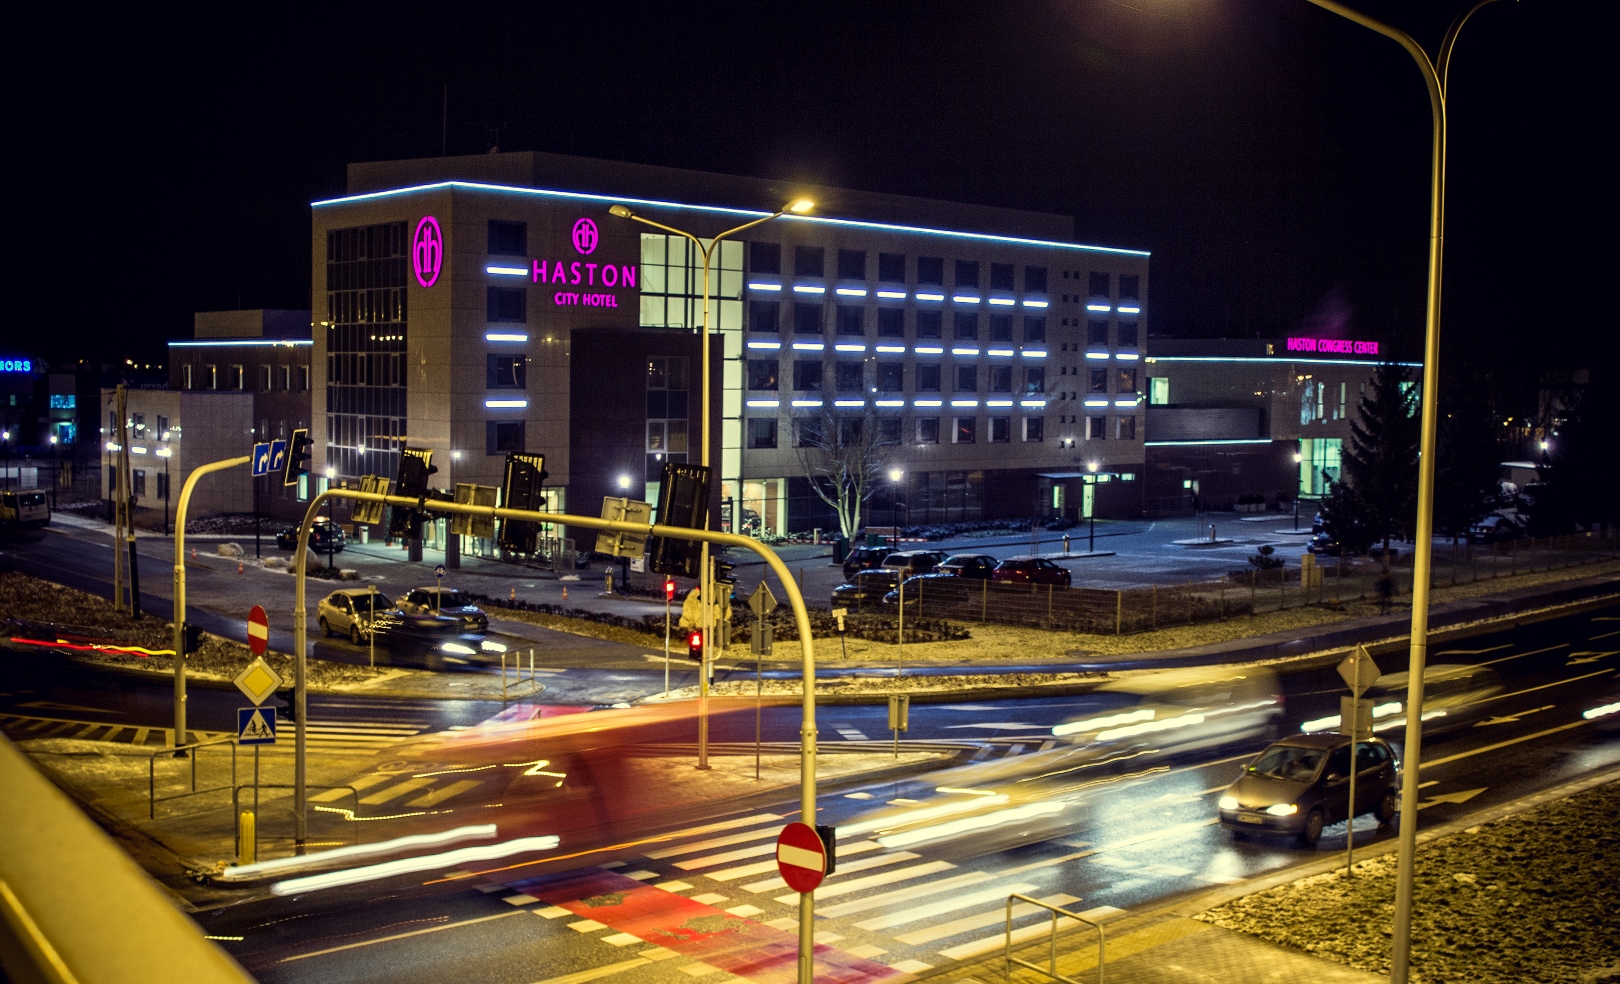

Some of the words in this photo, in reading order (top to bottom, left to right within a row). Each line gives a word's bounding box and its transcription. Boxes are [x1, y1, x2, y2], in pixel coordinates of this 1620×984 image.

[533, 259, 636, 287] HASTON
[554, 291, 580, 306] CITY
[583, 293, 618, 307] HOTEL
[1287, 337, 1317, 351] HASTON
[1318, 339, 1352, 354] CONGRESS
[1354, 341, 1379, 355] CENTER
